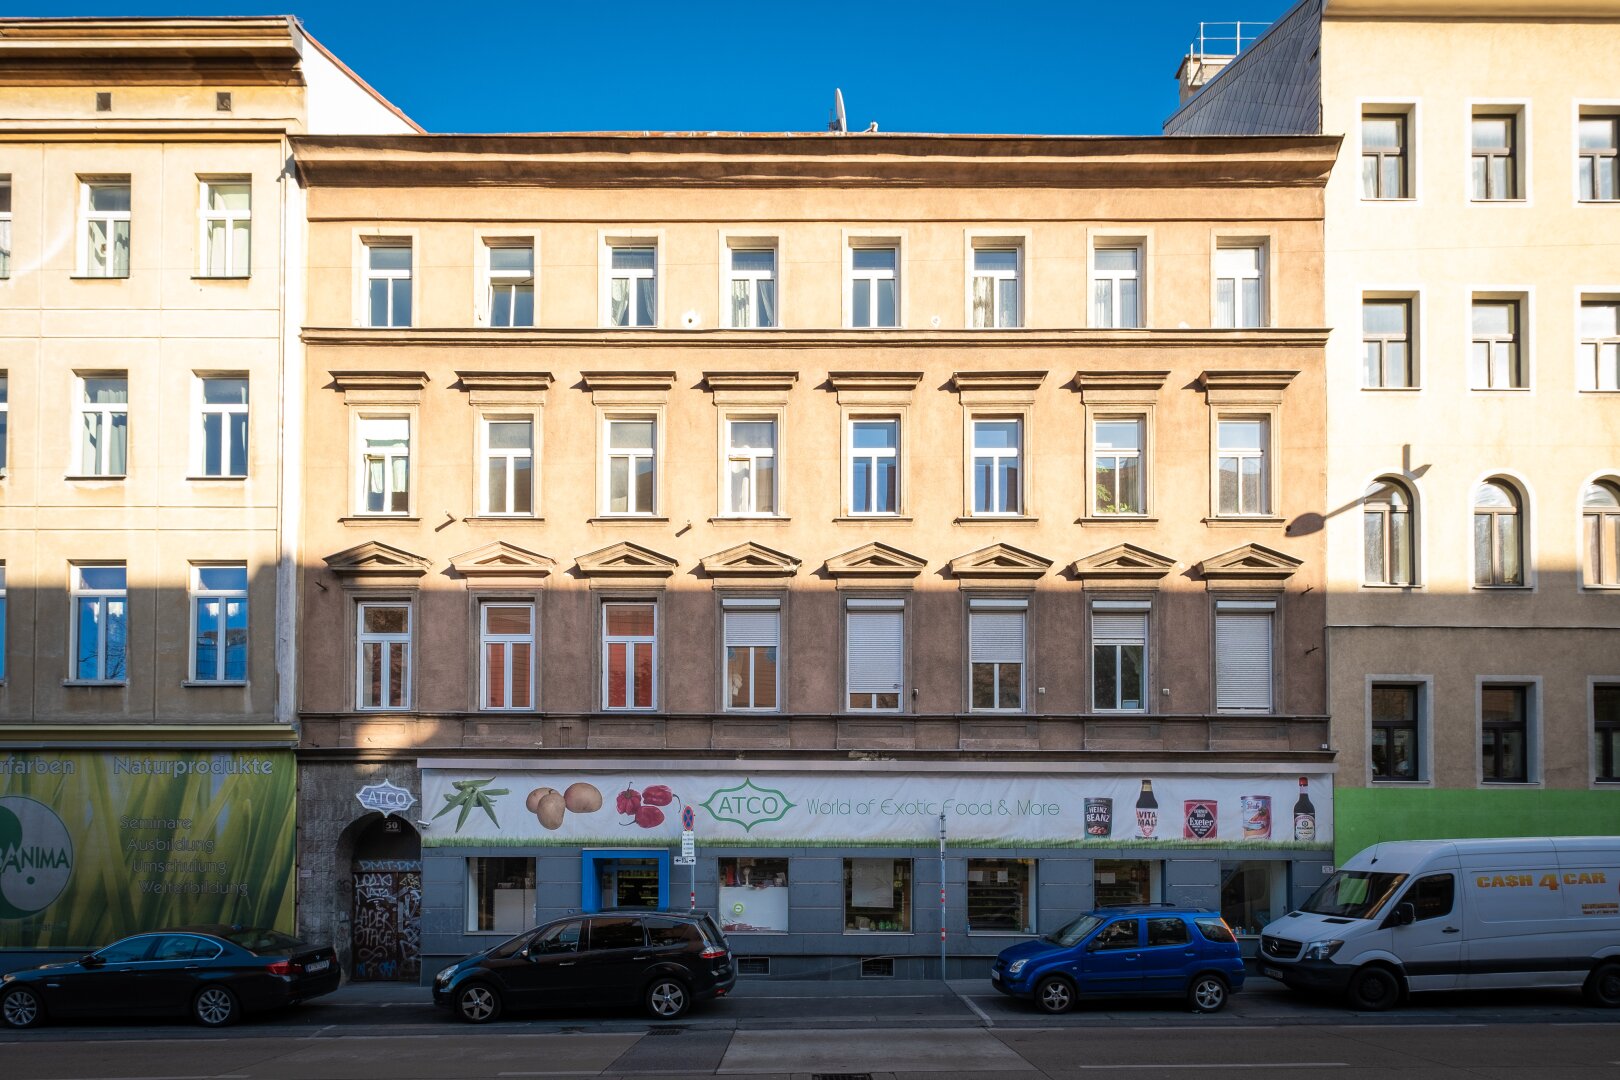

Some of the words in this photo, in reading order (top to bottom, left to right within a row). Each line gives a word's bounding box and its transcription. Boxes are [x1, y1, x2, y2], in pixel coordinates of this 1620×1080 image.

[113, 755, 274, 778] Naturprodukte
[367, 791, 407, 806] ATCO
[718, 796, 779, 815] ATCO
[806, 798, 851, 815] World
[856, 798, 876, 815] of
[880, 798, 938, 816] Exotic
[942, 798, 993, 816] Food
[998, 799, 1013, 815] &
[1017, 799, 1061, 816] More
[120, 815, 192, 830] Seminare
[1086, 813, 1110, 823] BEANZ
[1139, 811, 1156, 819] VITA
[1190, 817, 1214, 826] Exeter
[127, 838, 216, 853] Ausbildung
[132, 860, 228, 875] Umschulung
[138, 880, 249, 896] Weiterbildung
[1538, 873, 1560, 891] 4
[1562, 872, 1607, 885] CAR
